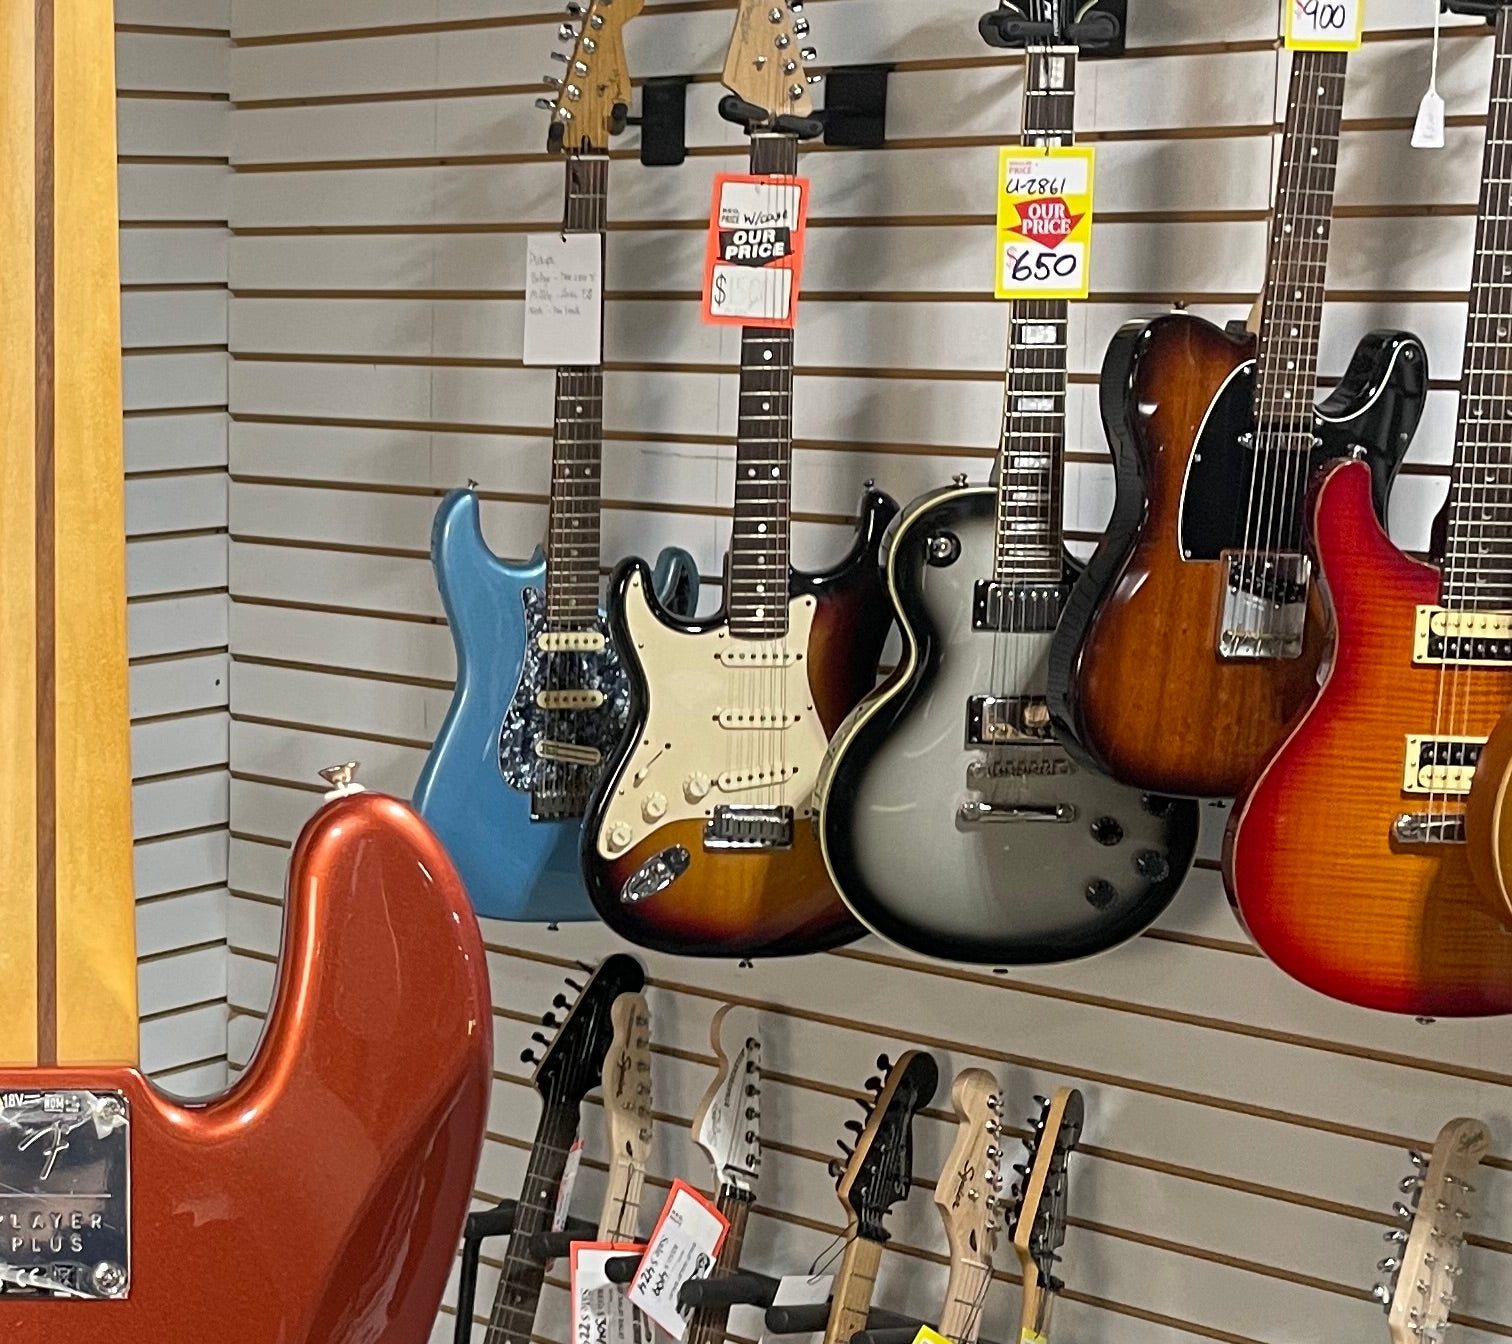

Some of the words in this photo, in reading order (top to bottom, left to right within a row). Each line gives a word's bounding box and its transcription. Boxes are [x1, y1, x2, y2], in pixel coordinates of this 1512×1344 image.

[1009, 167, 1032, 175] PRICE
[1006, 178, 1066, 195] U-2861
[1028, 203, 1065, 219] OUR
[1022, 218, 1072, 235] PRICE
[733, 229, 776, 244] OUR
[725, 242, 784, 260] PRICE
[2, 1093, 25, 1106] 18V
[952, 1160, 975, 1209] Squier
[11, 1237, 83, 1253] PLUS
